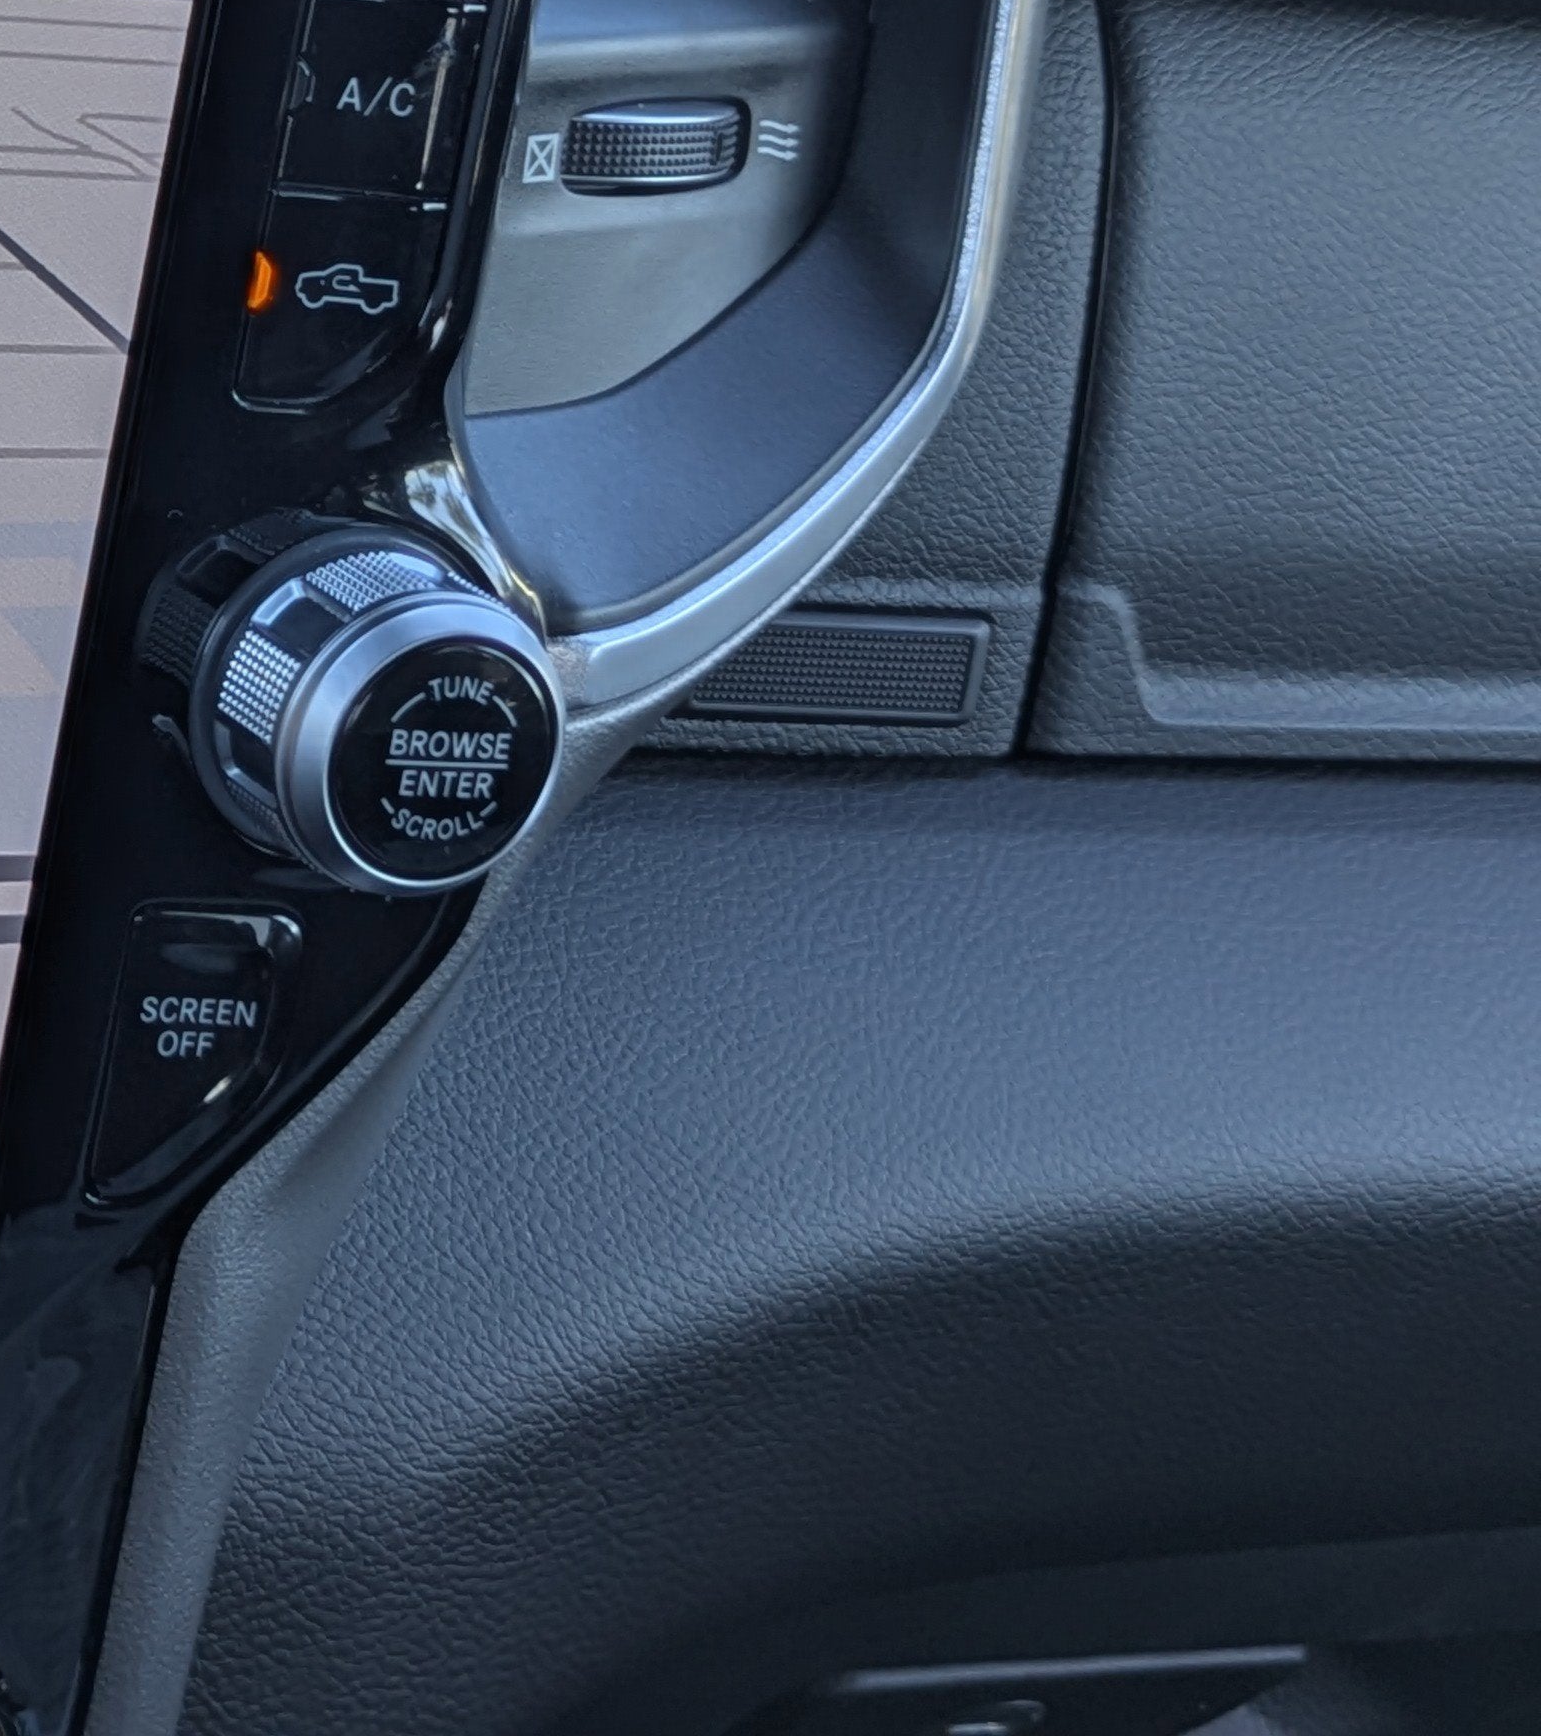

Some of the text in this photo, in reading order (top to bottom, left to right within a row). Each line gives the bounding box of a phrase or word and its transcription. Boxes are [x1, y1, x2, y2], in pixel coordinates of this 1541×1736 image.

[336, 75, 416, 117] A/C
[428, 675, 494, 706] TUNE
[389, 727, 512, 761] BROWSE
[398, 770, 494, 800] ENTER
[391, 807, 484, 841] SCROLL
[140, 995, 258, 1029] SCREEN
[157, 1029, 216, 1060] OFF
